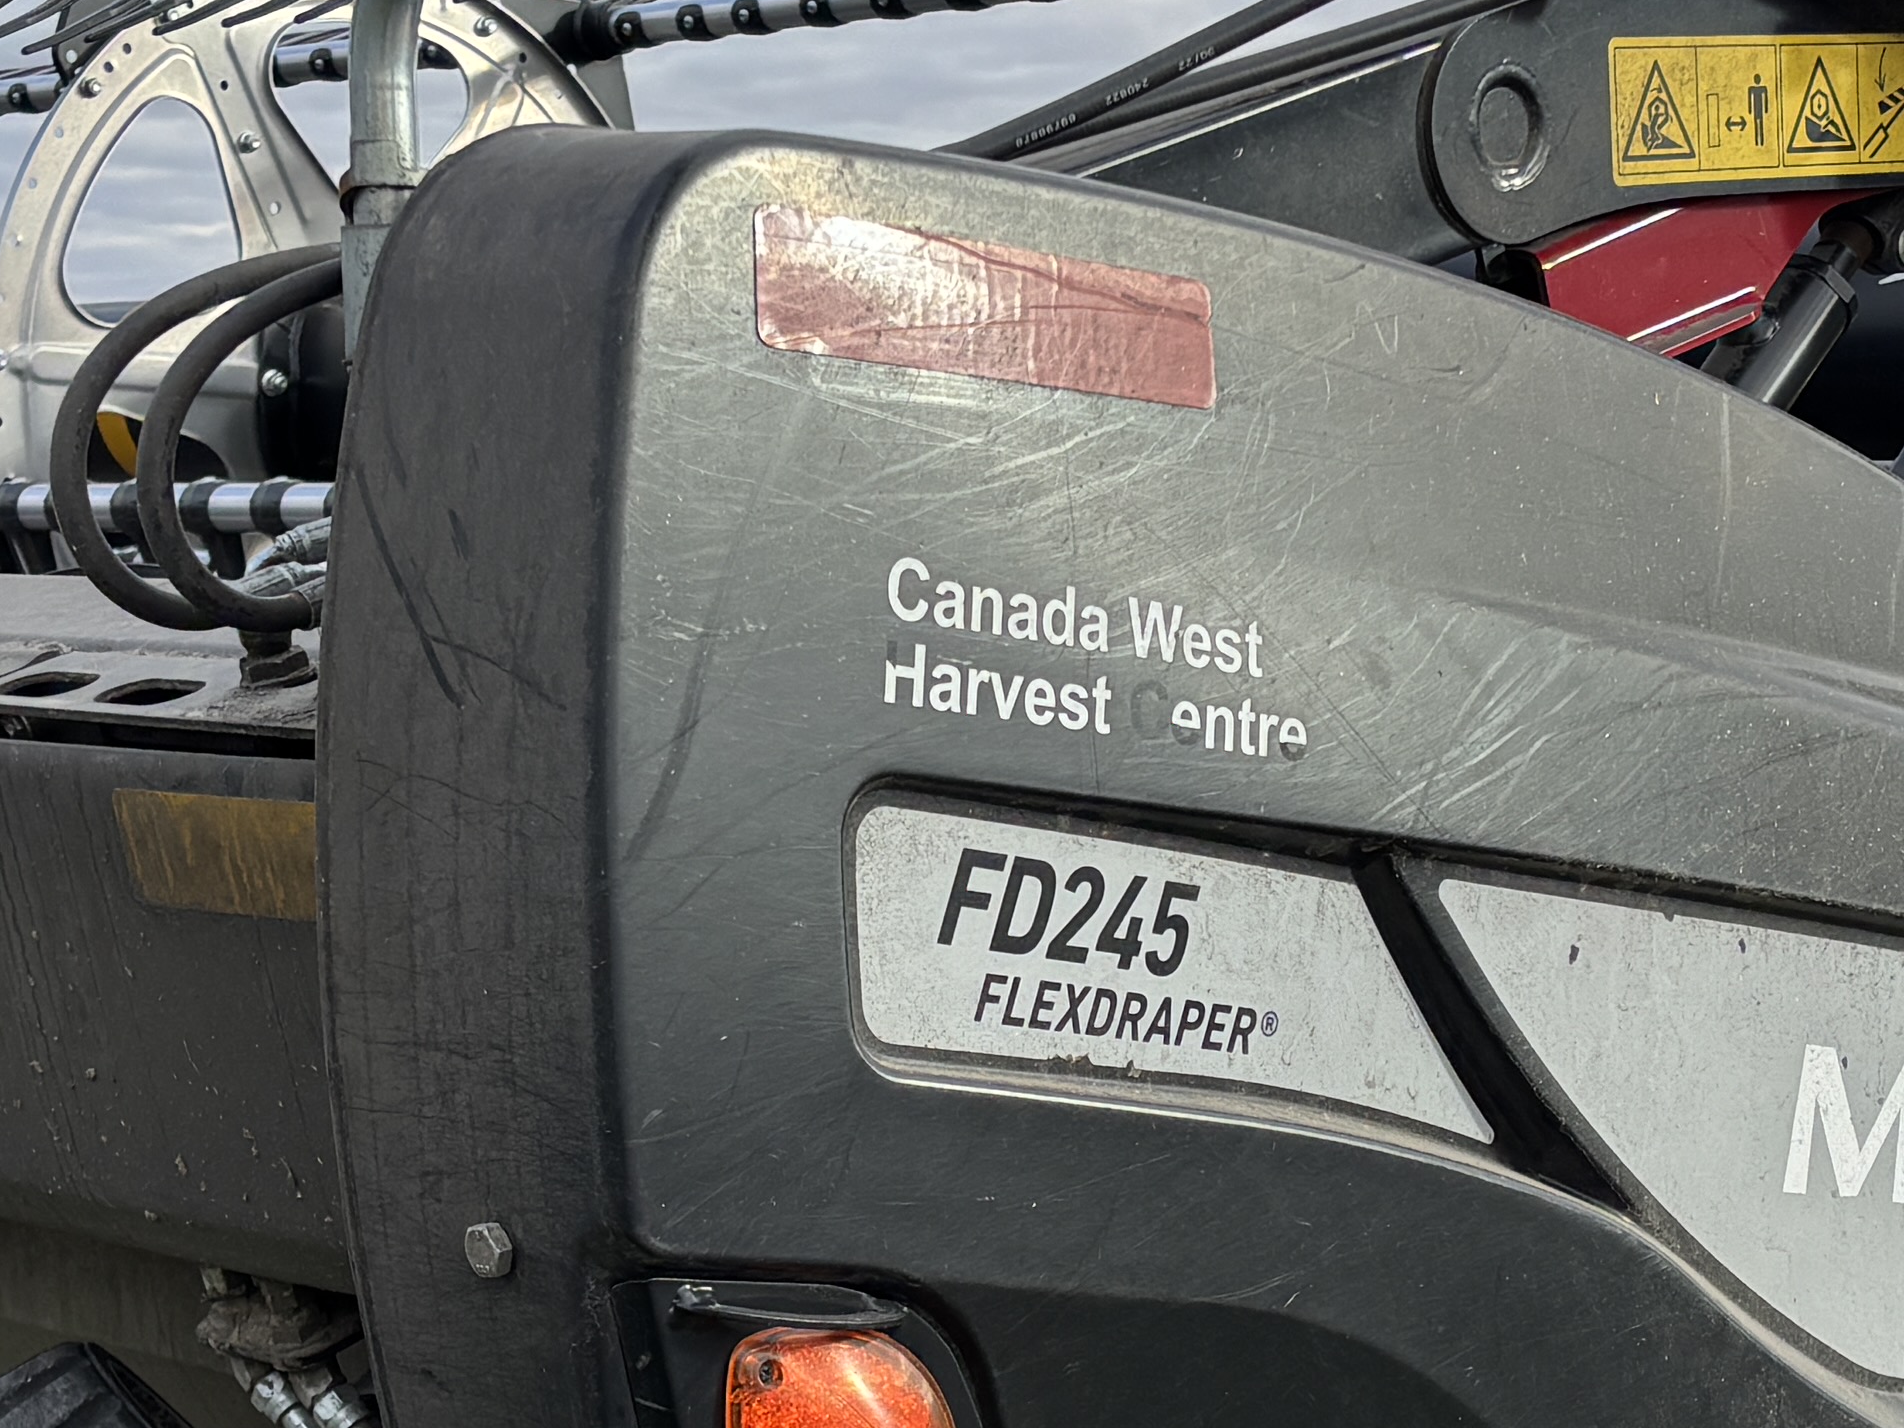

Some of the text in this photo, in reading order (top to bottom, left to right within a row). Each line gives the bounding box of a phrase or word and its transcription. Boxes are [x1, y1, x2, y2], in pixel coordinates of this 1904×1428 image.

[887, 556, 1264, 678] Canada West
[882, 641, 1112, 735] Harvest
[936, 847, 1201, 978] FD245
